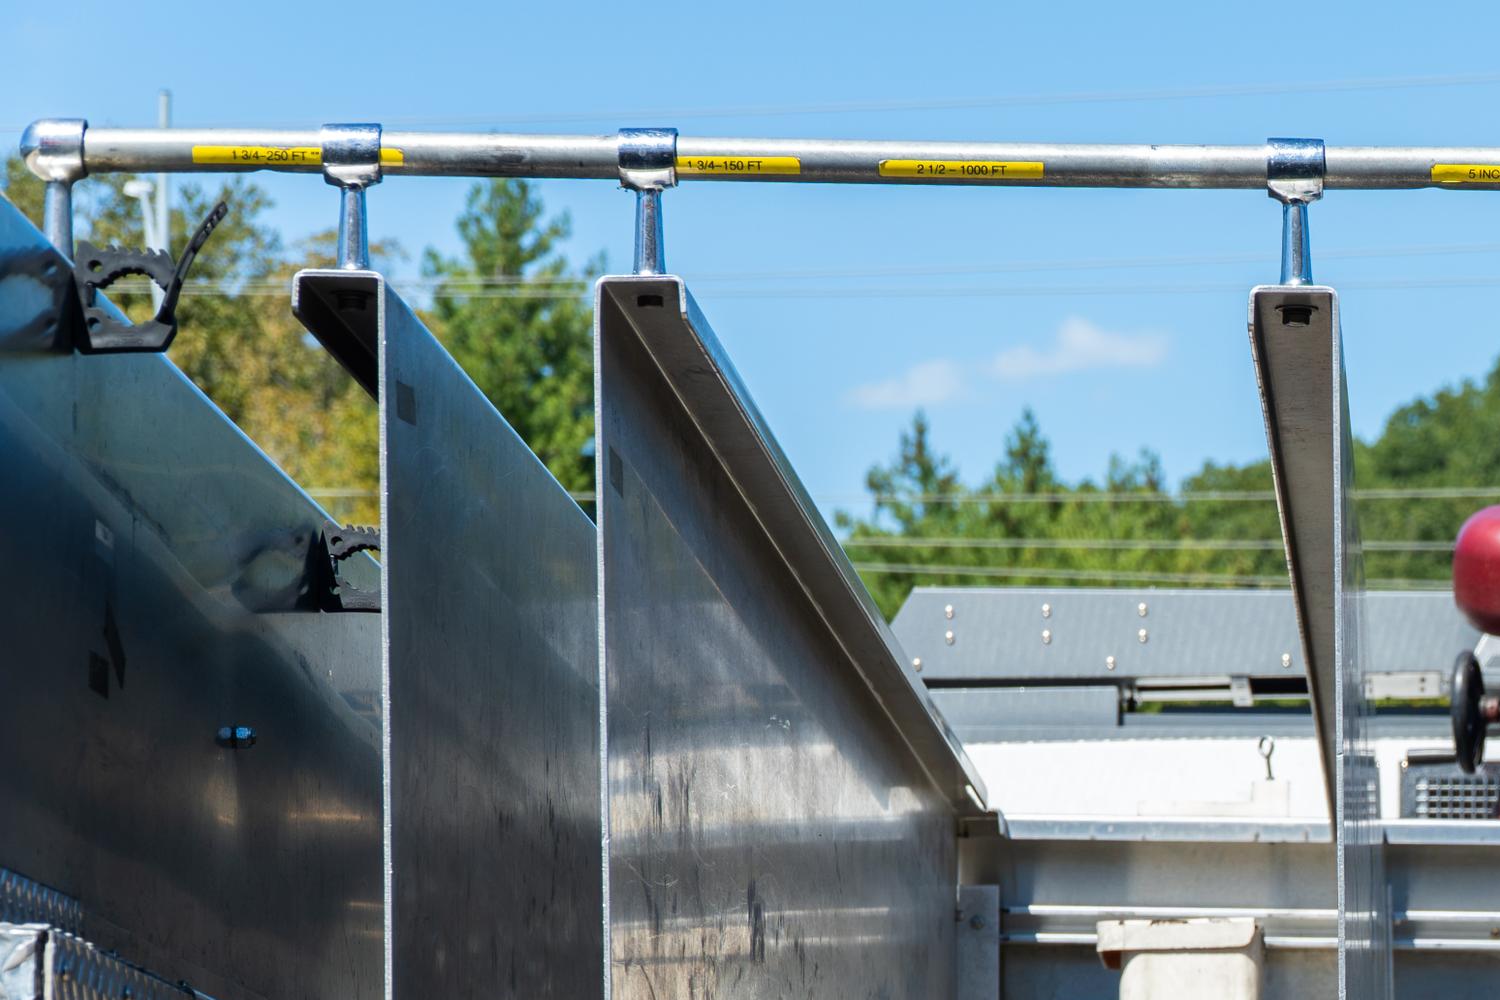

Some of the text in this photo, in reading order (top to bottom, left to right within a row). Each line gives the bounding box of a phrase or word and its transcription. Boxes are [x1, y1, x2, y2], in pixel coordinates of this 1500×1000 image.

[291, 151, 306, 161] FT
[747, 161, 763, 171] FT
[917, 164, 924, 174] 2
[929, 165, 945, 175] 1/2
[960, 165, 988, 175] 1000
[991, 166, 1007, 176] FT
[1468, 170, 1476, 179] 5
